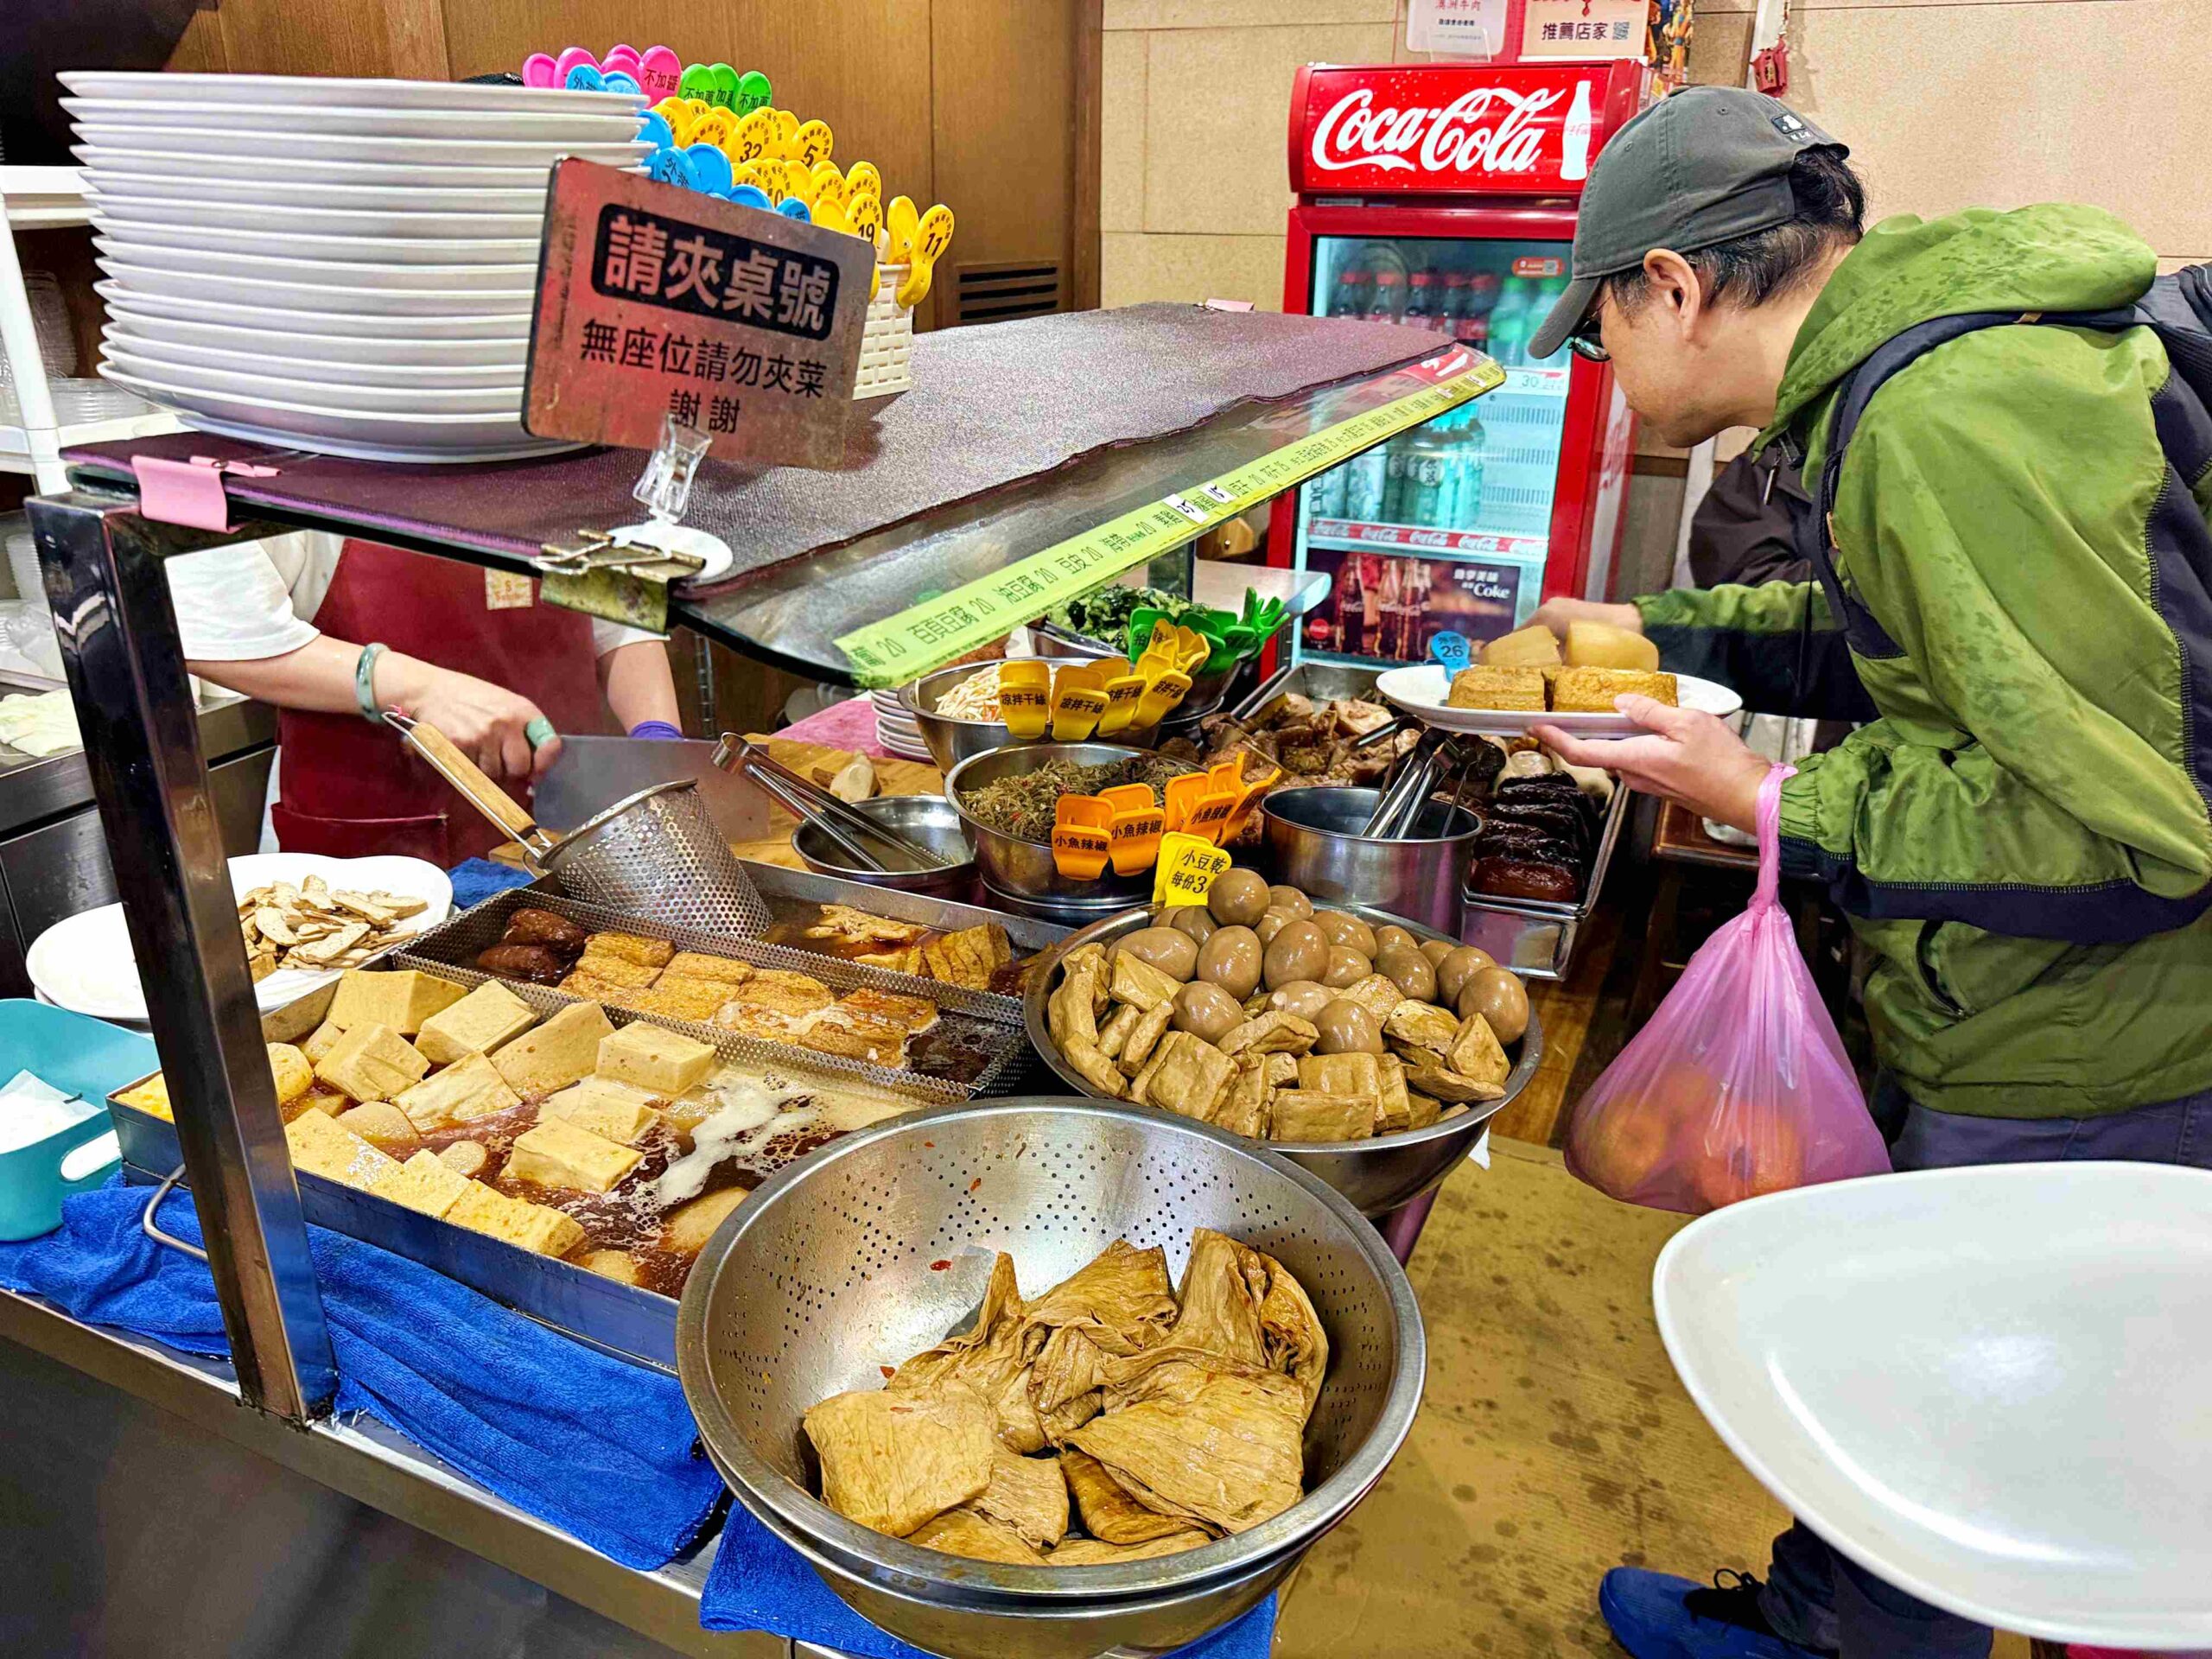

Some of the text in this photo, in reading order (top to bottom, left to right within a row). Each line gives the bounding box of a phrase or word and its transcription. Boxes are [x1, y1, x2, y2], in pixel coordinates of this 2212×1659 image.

[1541, 21, 1609, 41] 推薦店家
[1312, 88, 1567, 172] Coca-Cola
[739, 141, 763, 163] 32
[801, 144, 819, 168] 5
[857, 222, 875, 245] 19
[924, 232, 943, 257] 11
[603, 214, 833, 334] 請夾桌號
[580, 318, 828, 399] 無座位請勿夾菜
[1522, 374, 1539, 388] 30
[669, 388, 741, 435] 謝謝
[876, 638, 906, 658] 20
[906, 605, 980, 645] 百頁豆腐
[969, 597, 996, 615] 20
[993, 575, 1046, 605] 油豆腐
[1034, 568, 1059, 584] 20
[1054, 552, 1092, 575] 豆皮
[1081, 545, 1103, 562] 20
[1136, 520, 1157, 536] 20
[1473, 582, 1510, 599] Coke
[1440, 645, 1465, 658] 26
[1110, 819, 1163, 841] 小魚辣椒
[1055, 835, 1109, 853] 小魚辣椒
[1181, 849, 1227, 875] 小豆乾
[1171, 870, 1211, 894] 每份3
